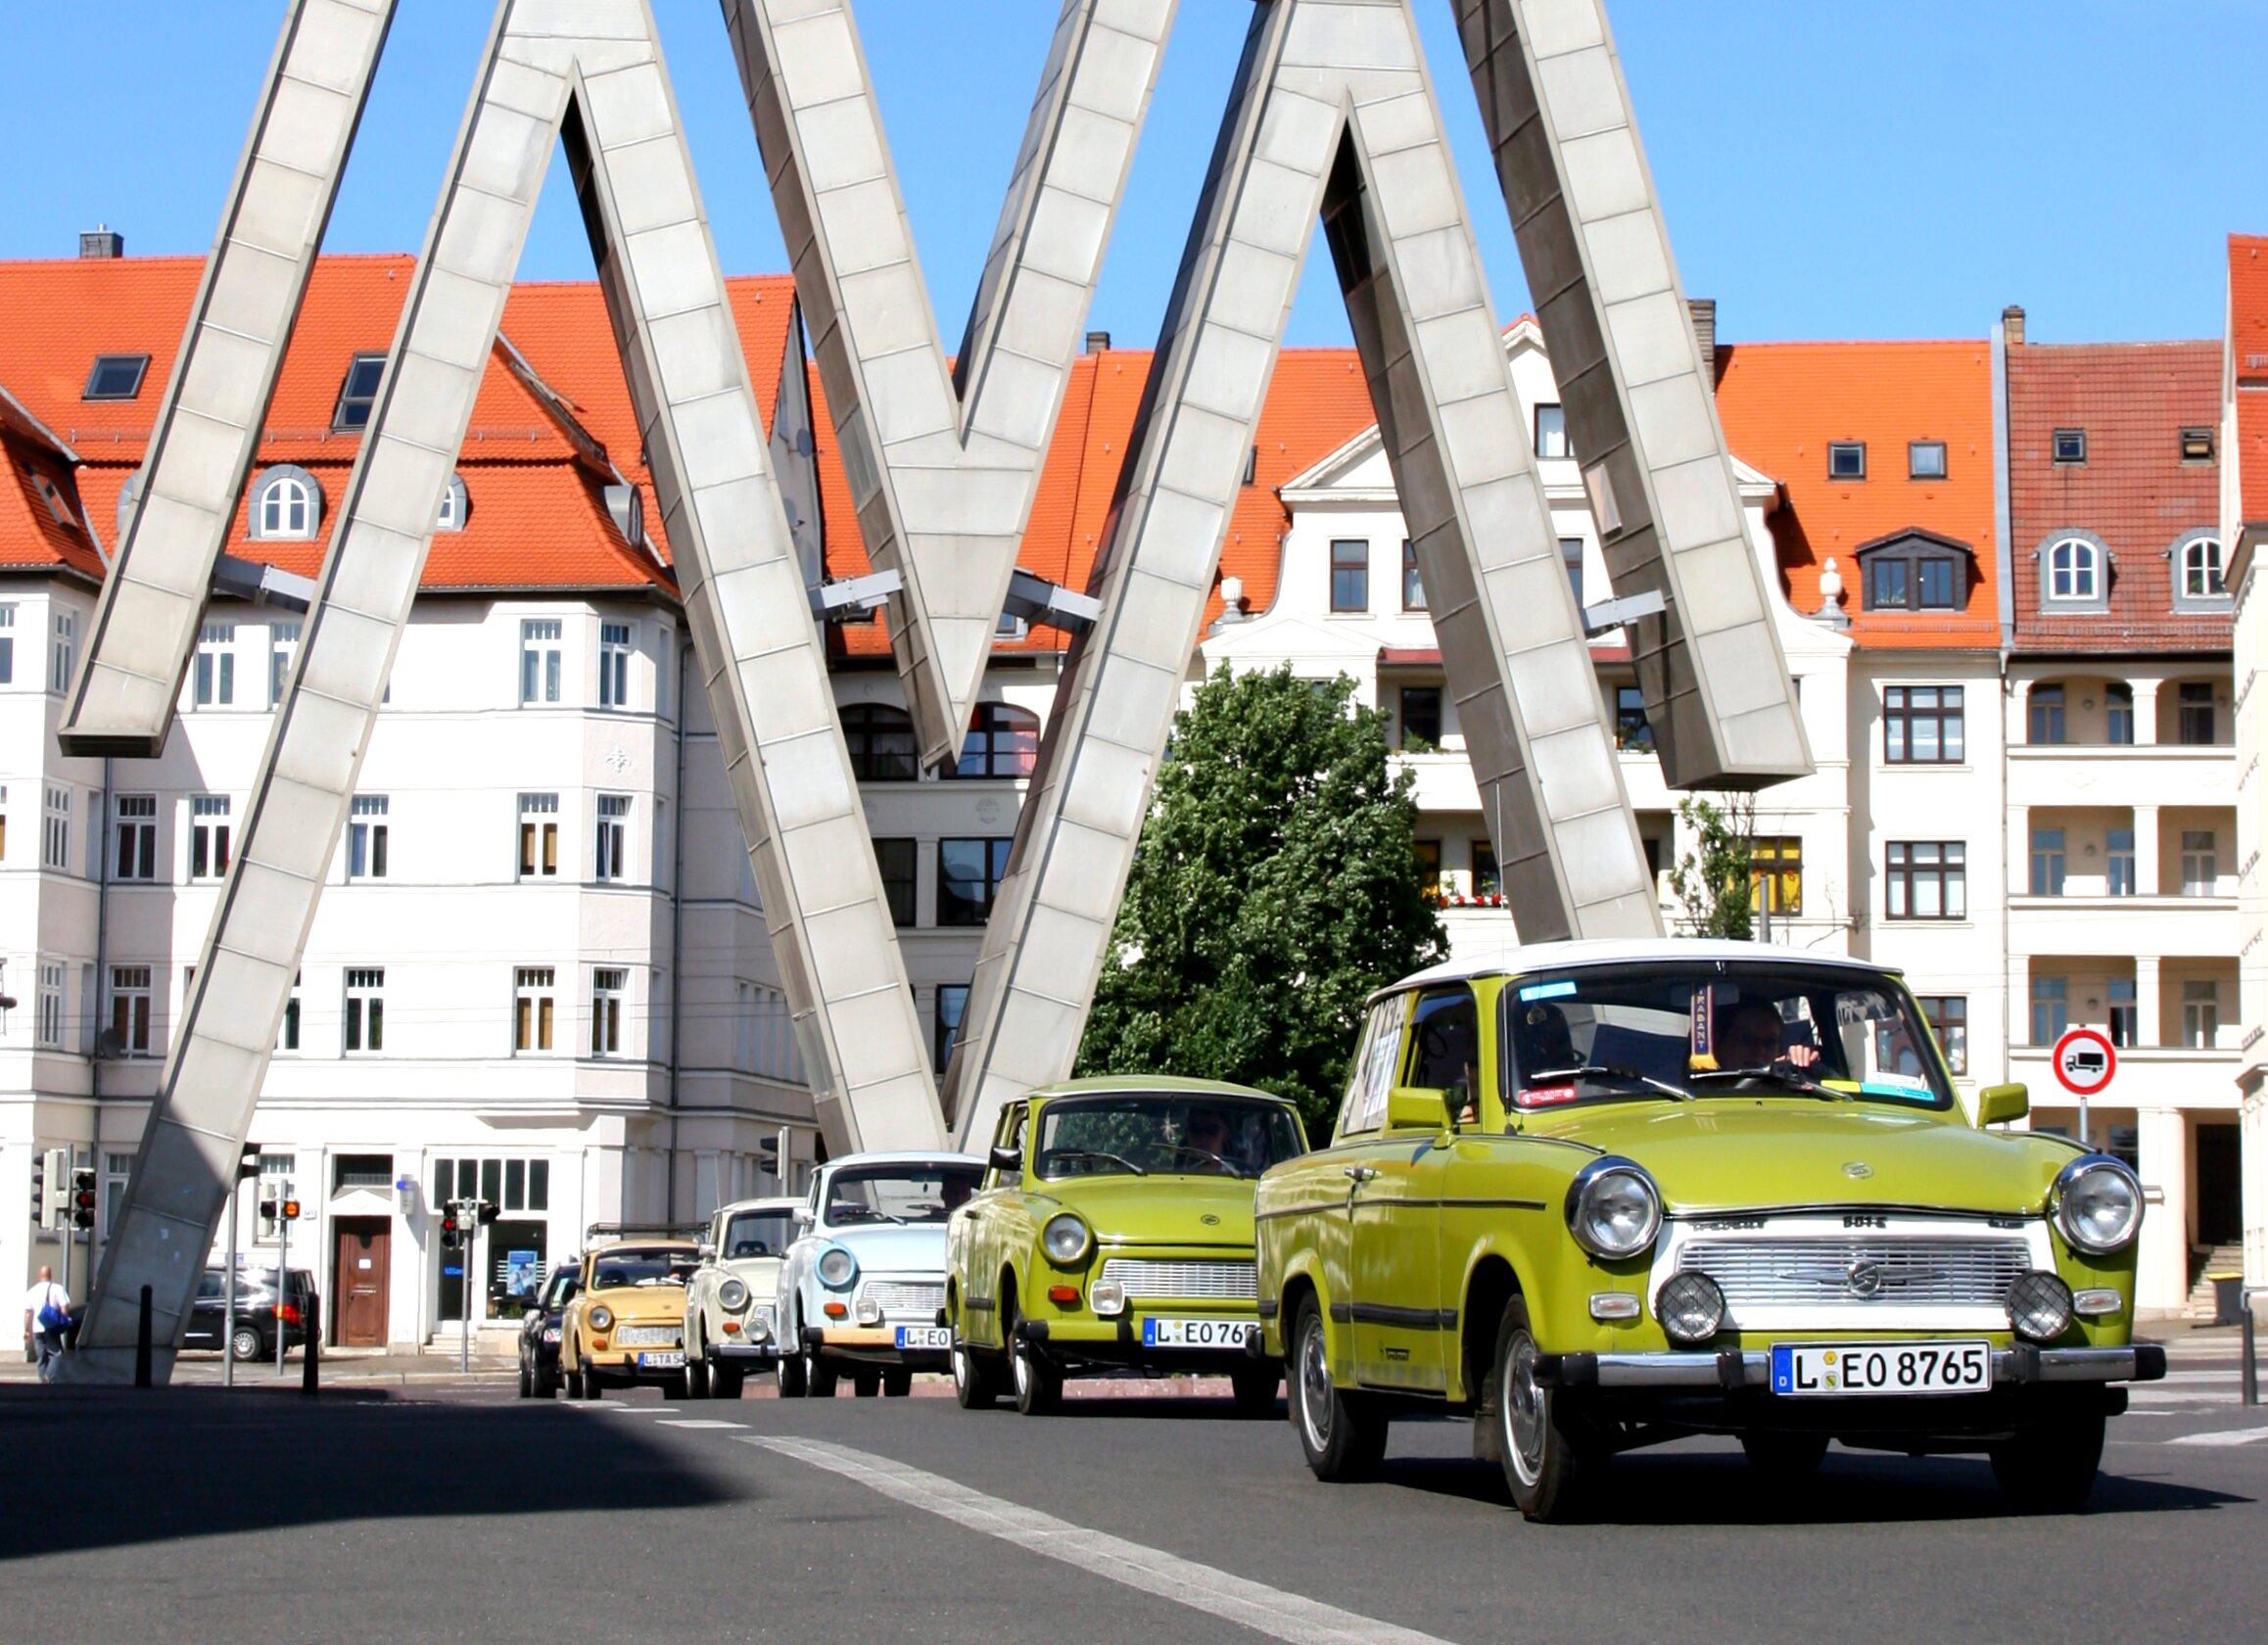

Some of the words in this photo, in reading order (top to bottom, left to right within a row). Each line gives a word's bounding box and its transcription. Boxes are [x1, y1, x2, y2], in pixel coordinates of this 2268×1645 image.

[907, 1329, 918, 1345] L
[1157, 1322, 1170, 1342] L
[1185, 1322, 1213, 1343] EO
[1796, 1354, 1819, 1389] L
[1842, 1352, 1888, 1388] EO
[1897, 1349, 1983, 1386] 8765
